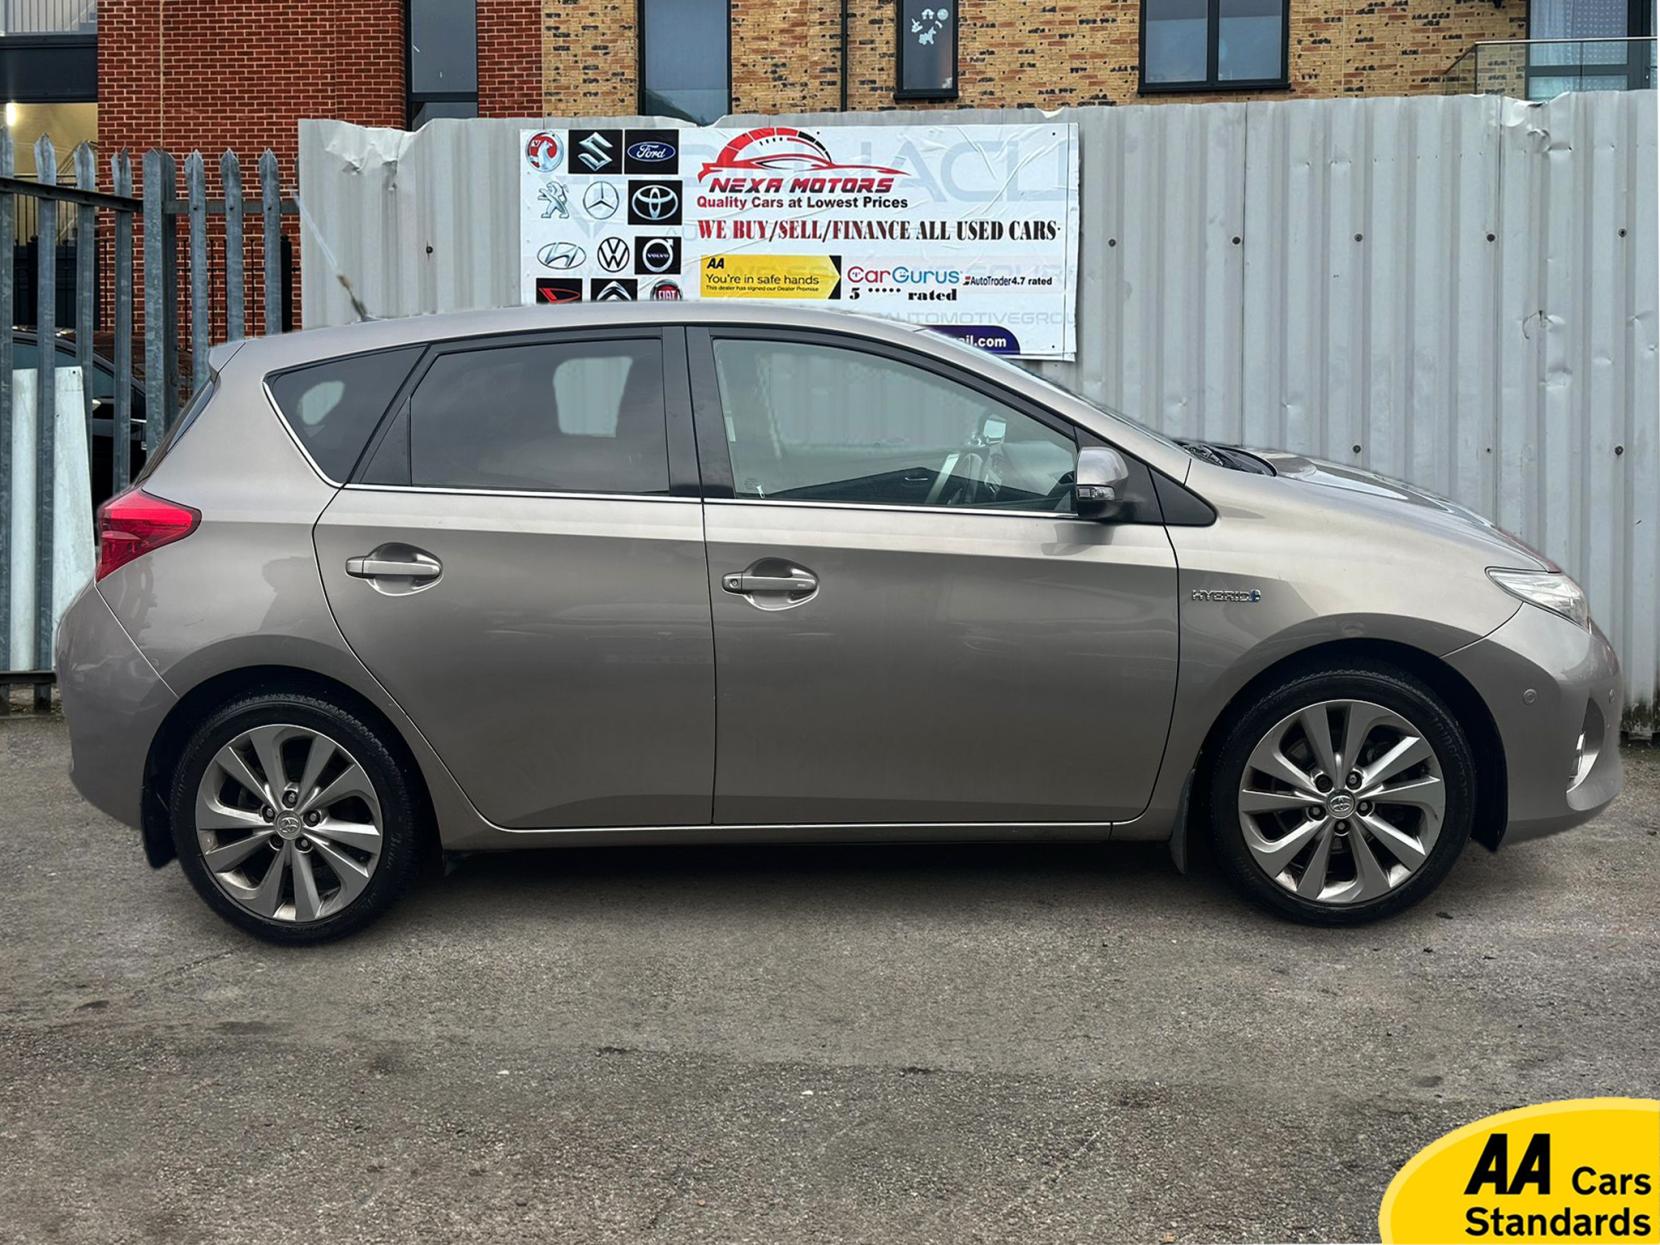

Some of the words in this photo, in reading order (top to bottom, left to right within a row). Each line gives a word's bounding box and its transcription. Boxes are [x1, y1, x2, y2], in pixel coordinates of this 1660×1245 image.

[636, 144, 666, 158] Ford
[709, 178, 784, 193] NEXA
[789, 178, 894, 193] MOTORS
[697, 196, 747, 210] Quality
[752, 196, 784, 208] Cars
[788, 197, 802, 208] at
[807, 196, 858, 208] Lowest
[863, 196, 908, 208] Prices
[697, 220, 727, 239] WE
[733, 220, 911, 242] BUY/SELL/FINANCE
[916, 221, 950, 240] ALL
[956, 221, 1004, 240] USED
[1009, 221, 1057, 240] CARS
[707, 258, 725, 269] AA
[706, 274, 741, 284] You're
[744, 275, 754, 284] in
[757, 274, 781, 284] safe
[783, 275, 820, 285] hands
[847, 266, 960, 284] CarGurus
[1028, 277, 1052, 285] rated
[849, 287, 860, 300] 5
[908, 288, 957, 301] rated
[1192, 589, 1250, 602] HYBRID
